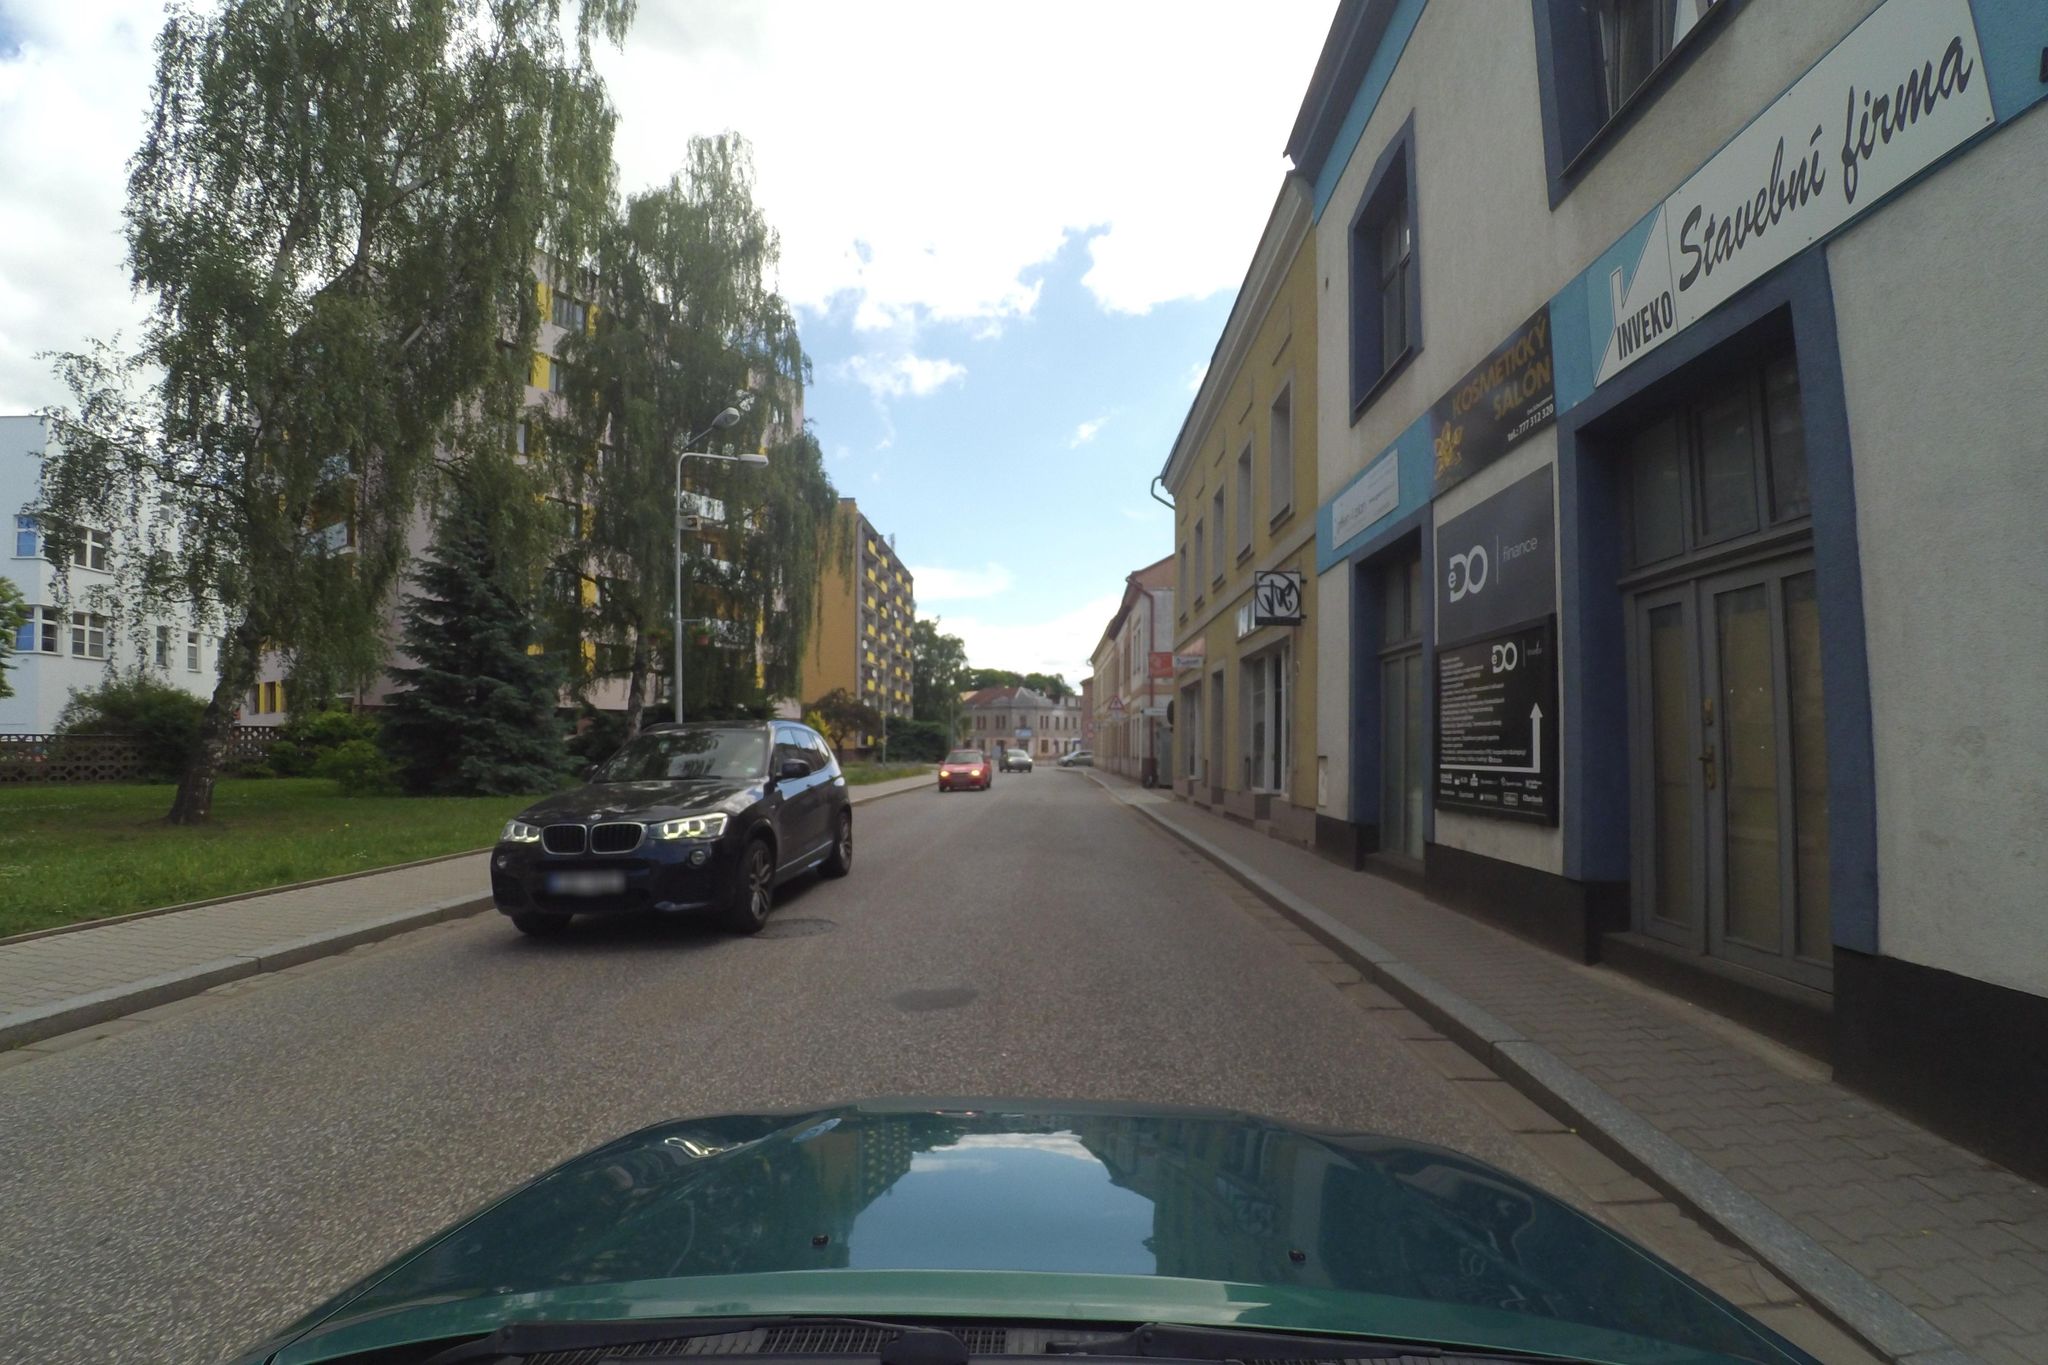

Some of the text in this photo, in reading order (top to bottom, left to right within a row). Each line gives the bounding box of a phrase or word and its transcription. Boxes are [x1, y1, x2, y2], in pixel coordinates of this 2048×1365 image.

[1679, 35, 1974, 293] Stavební firma
[1617, 290, 1674, 361] INVEKO
[1452, 316, 1547, 416] KOSMETICKÝ
[1493, 355, 1552, 421] SALÓN
[1518, 418, 1530, 435] 777
[1530, 411, 1542, 427] 312
[1542, 403, 1554, 420] 320
[1503, 537, 1538, 561] finance
